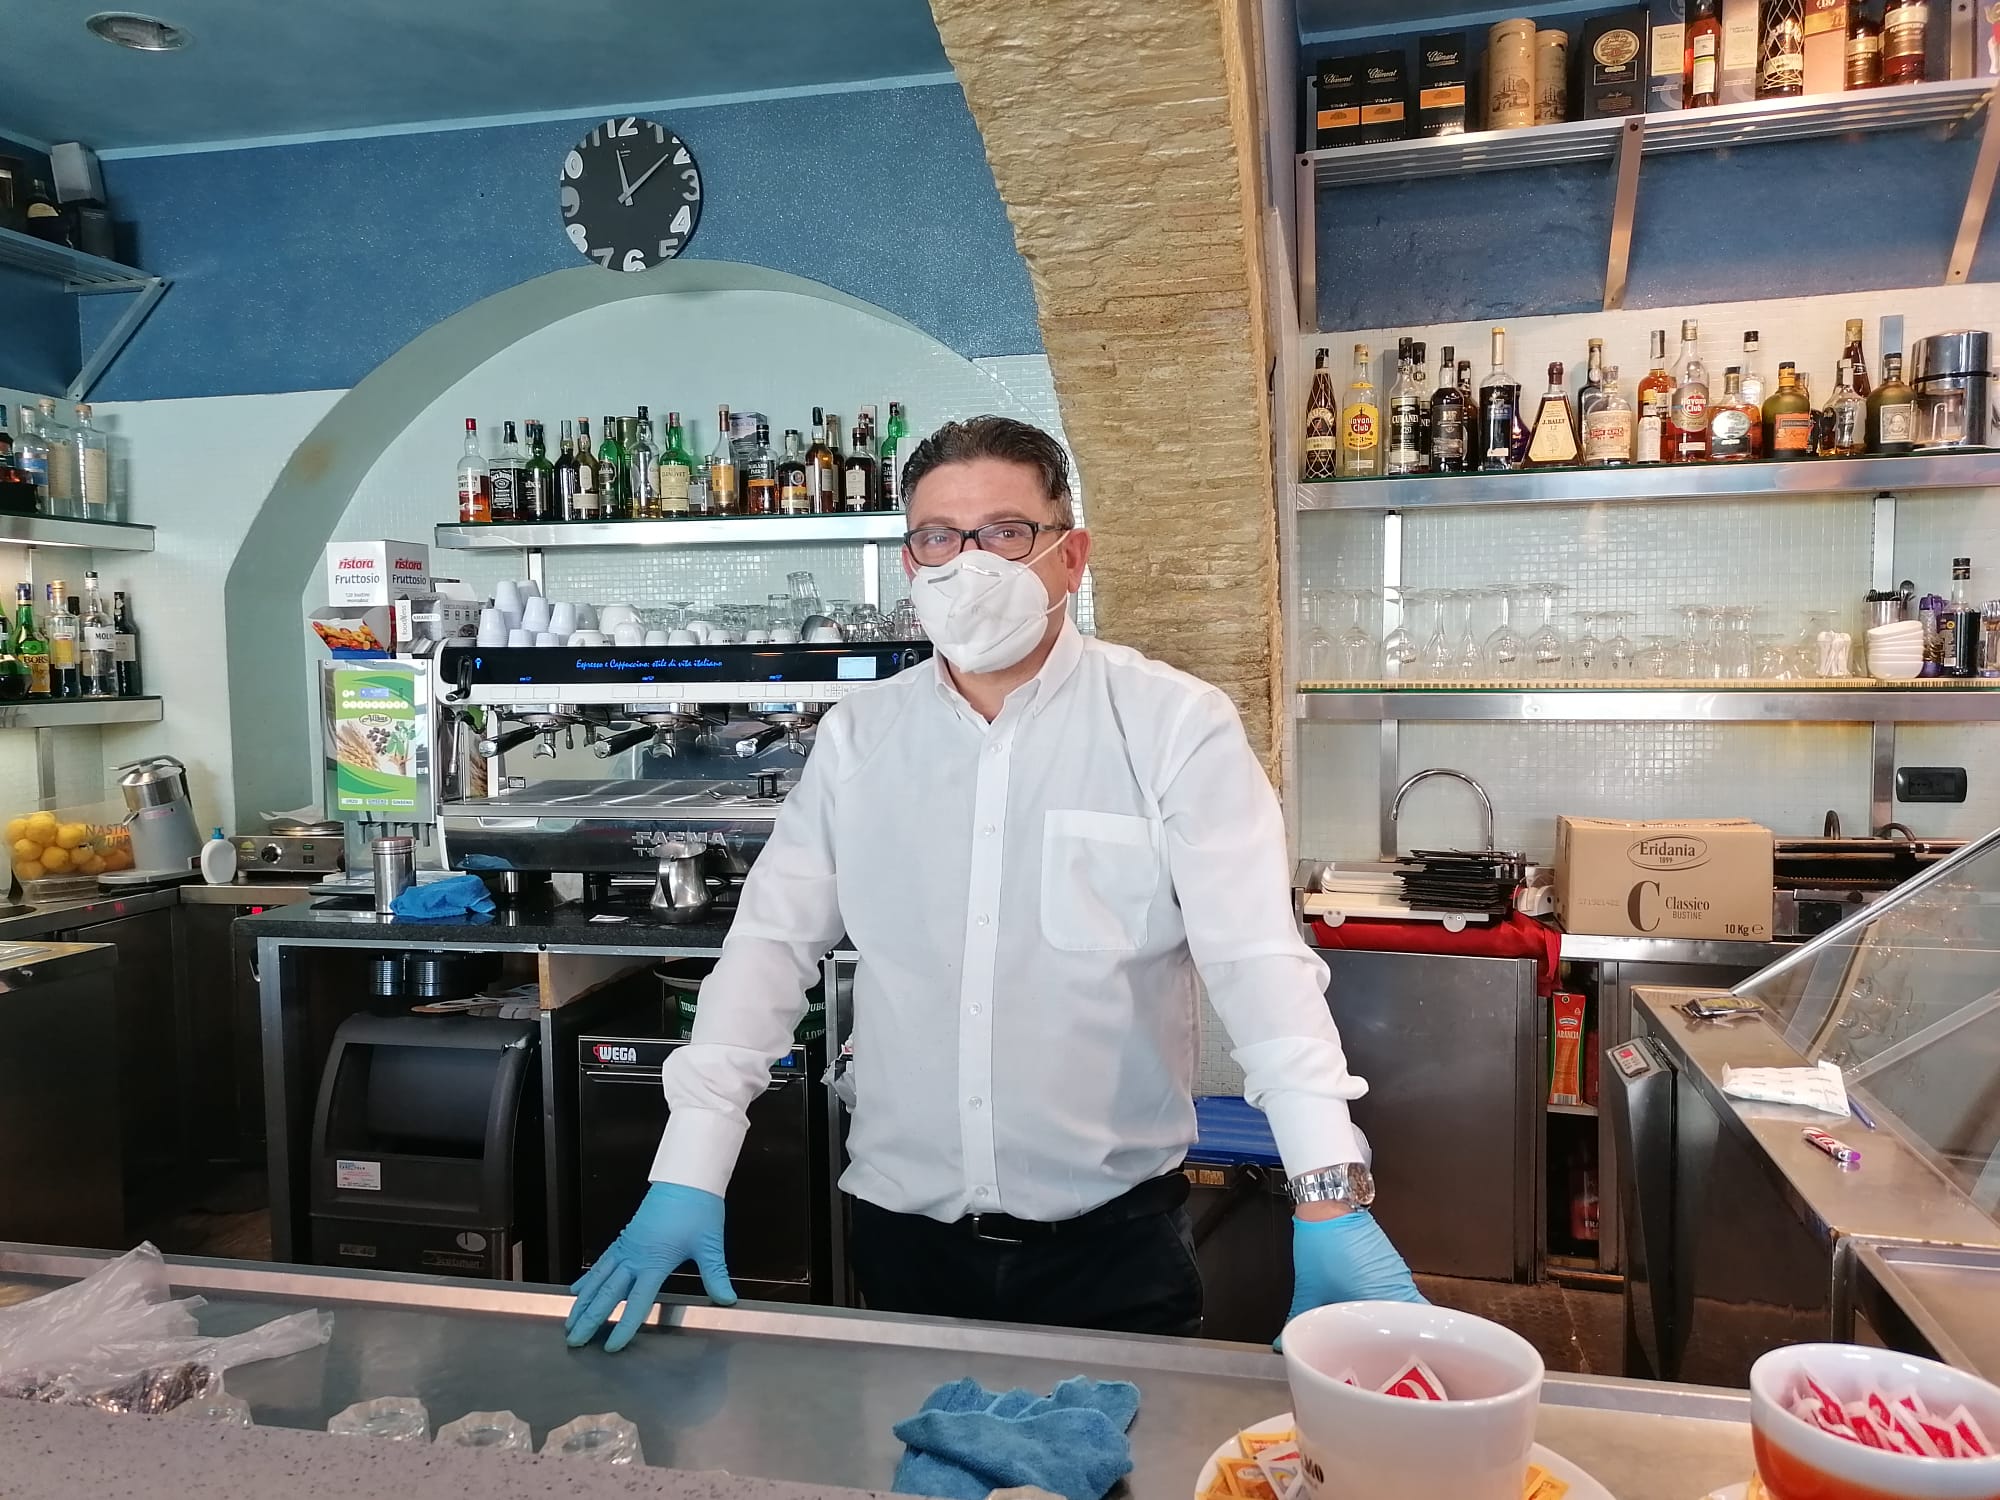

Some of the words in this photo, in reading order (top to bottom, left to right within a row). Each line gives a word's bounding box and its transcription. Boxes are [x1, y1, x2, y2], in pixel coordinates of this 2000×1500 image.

[607, 116, 638, 138] 12
[680, 169, 700, 201] 3
[670, 205, 691, 235] 4
[591, 247, 614, 270] 7
[623, 249, 647, 272] 6
[1392, 414, 1419, 424] CUANEY
[1353, 424, 1369, 432] Club
[339, 557, 374, 569] ristora
[395, 558, 422, 570] ristora
[335, 573, 380, 584] Fruttosio
[392, 574, 427, 584] Fruttosio
[632, 831, 727, 846] FAEMA
[1640, 841, 1695, 856] Eridania
[1627, 880, 1660, 932] C
[1665, 896, 1710, 911] Classico
[1672, 911, 1703, 919] BUSTINE
[1725, 924, 1735, 934] 10
[1737, 924, 1749, 936] Kg
[600, 1046, 637, 1061] WEGA
